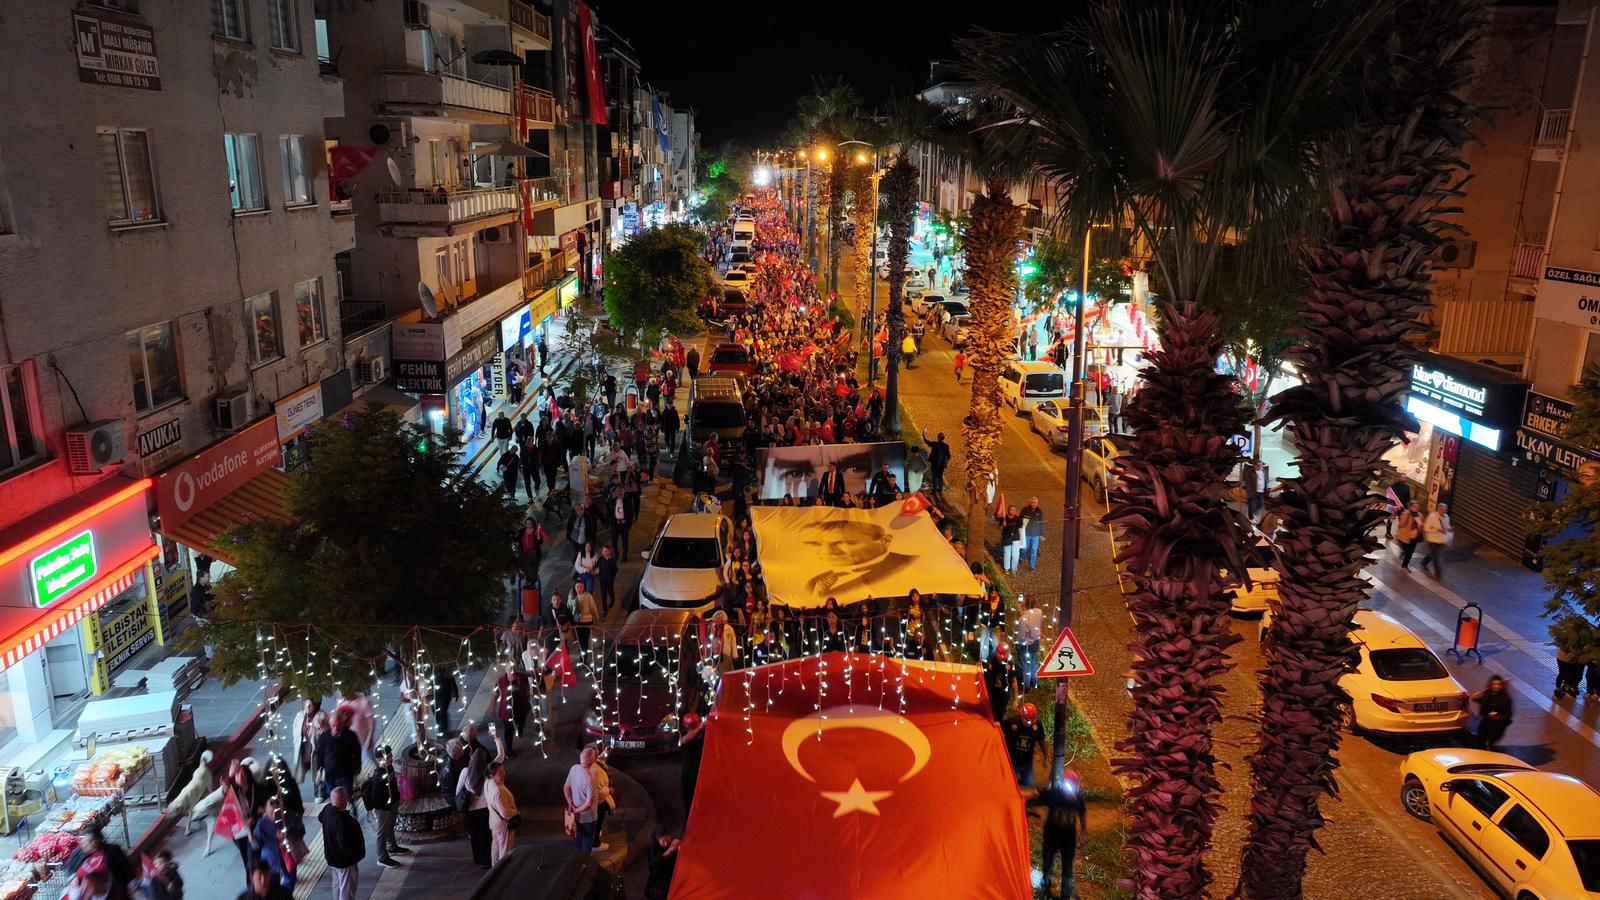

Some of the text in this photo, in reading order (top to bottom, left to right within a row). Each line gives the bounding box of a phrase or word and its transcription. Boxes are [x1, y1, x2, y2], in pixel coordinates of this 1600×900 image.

[1548, 269, 1571, 280] ÖZEL
[400, 361, 437, 376] FEHİM
[397, 377, 442, 391] ELEKTRİK
[1442, 375, 1486, 404] diamond
[1527, 412, 1558, 435] ERKEK
[140, 420, 180, 458] AVUKAT
[196, 450, 248, 491] vodafone
